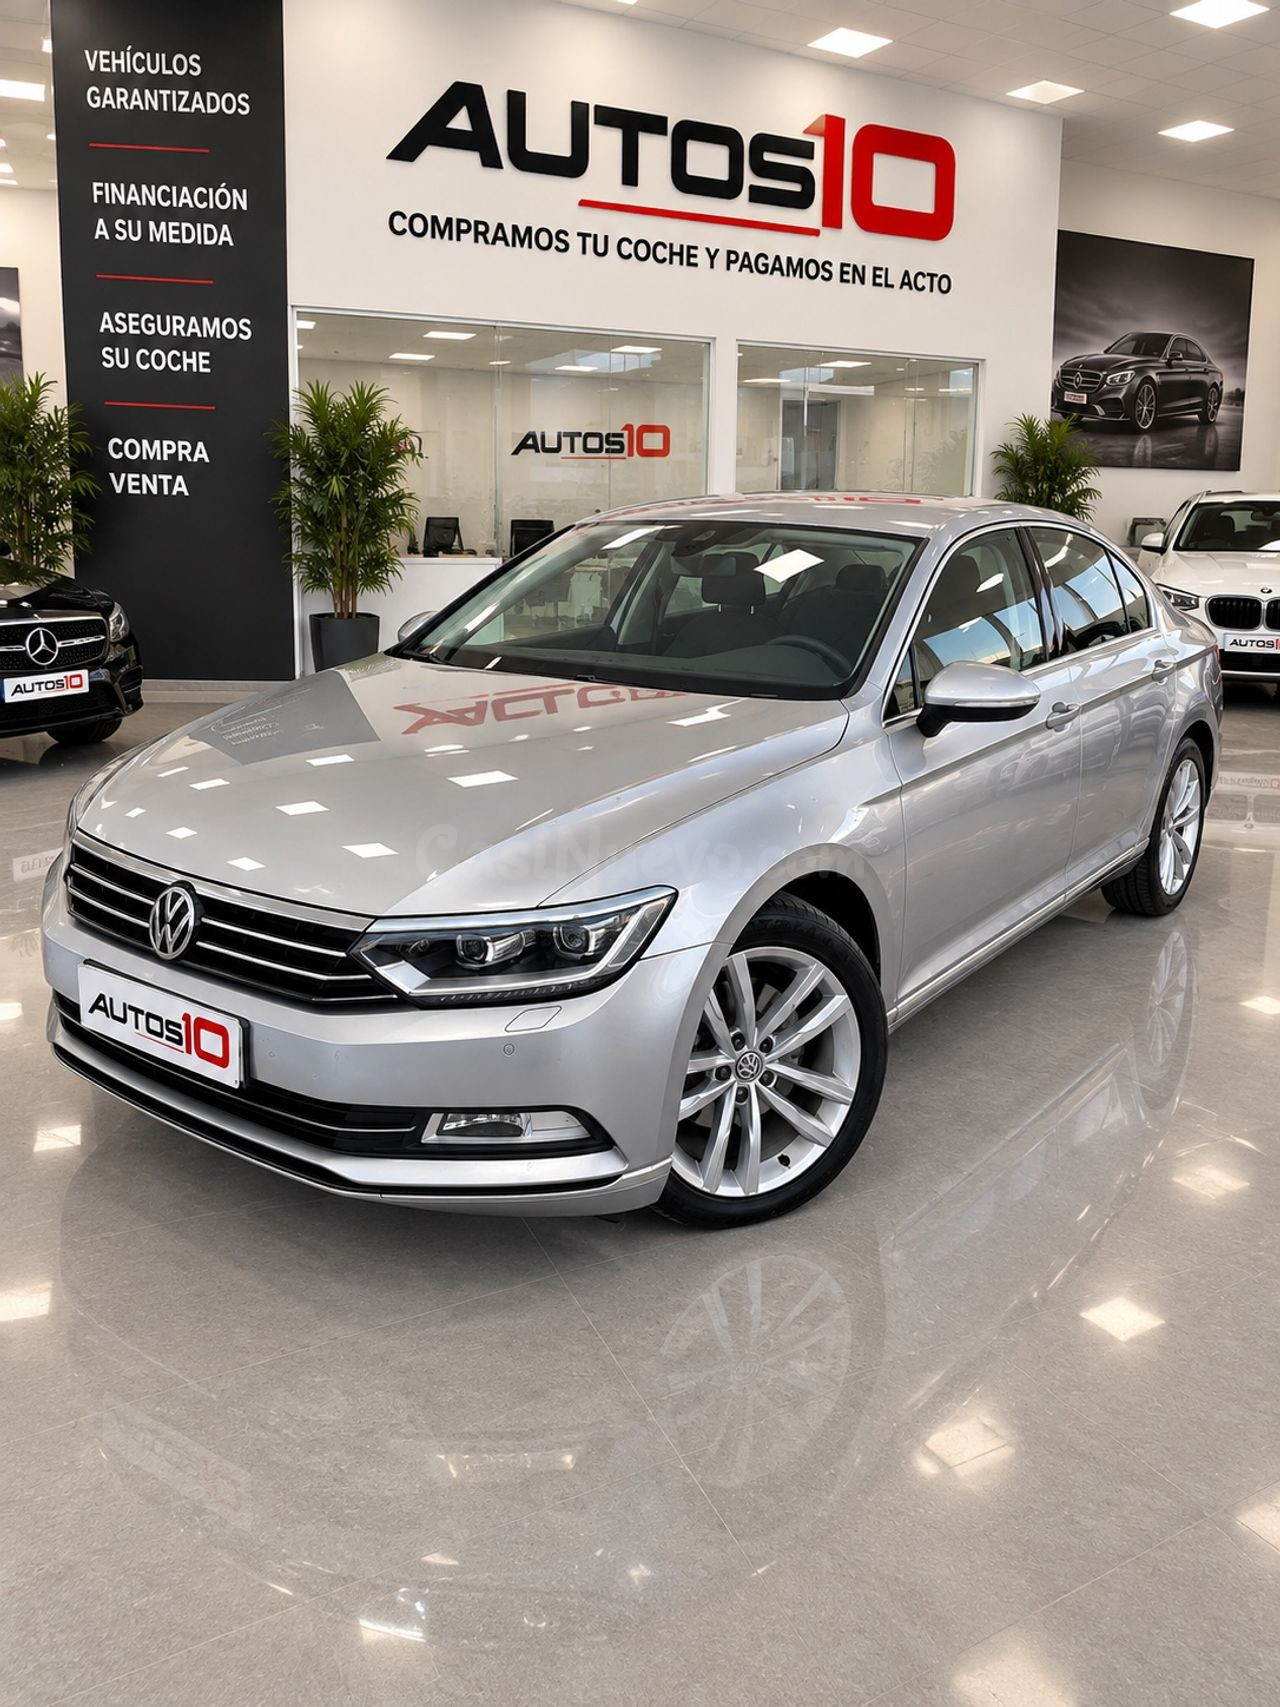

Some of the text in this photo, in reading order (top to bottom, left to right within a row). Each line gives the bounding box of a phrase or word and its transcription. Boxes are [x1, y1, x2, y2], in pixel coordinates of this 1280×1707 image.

[84, 45, 202, 76] VEHÍCULOS
[86, 86, 250, 115] GARANTIZADOS
[386, 80, 957, 242] AUTOS10
[92, 182, 248, 210] FINANCIACIÓN
[94, 218, 234, 246] A SU MEDIDA
[388, 210, 952, 295] COMPRAMOS TU COCHE Y PAGAMOS EN EL ACTO
[99, 312, 252, 340] ASEGURAMOS
[101, 347, 211, 373] SU COCHE
[107, 438, 210, 462] COMPRA
[511, 424, 671, 458] AUTOS10
[109, 473, 189, 496] VENTA
[1229, 638, 1280, 650] AUTOS1
[11, 674, 83, 696] AUTOS10
[88, 992, 230, 1069] AUTOS10
